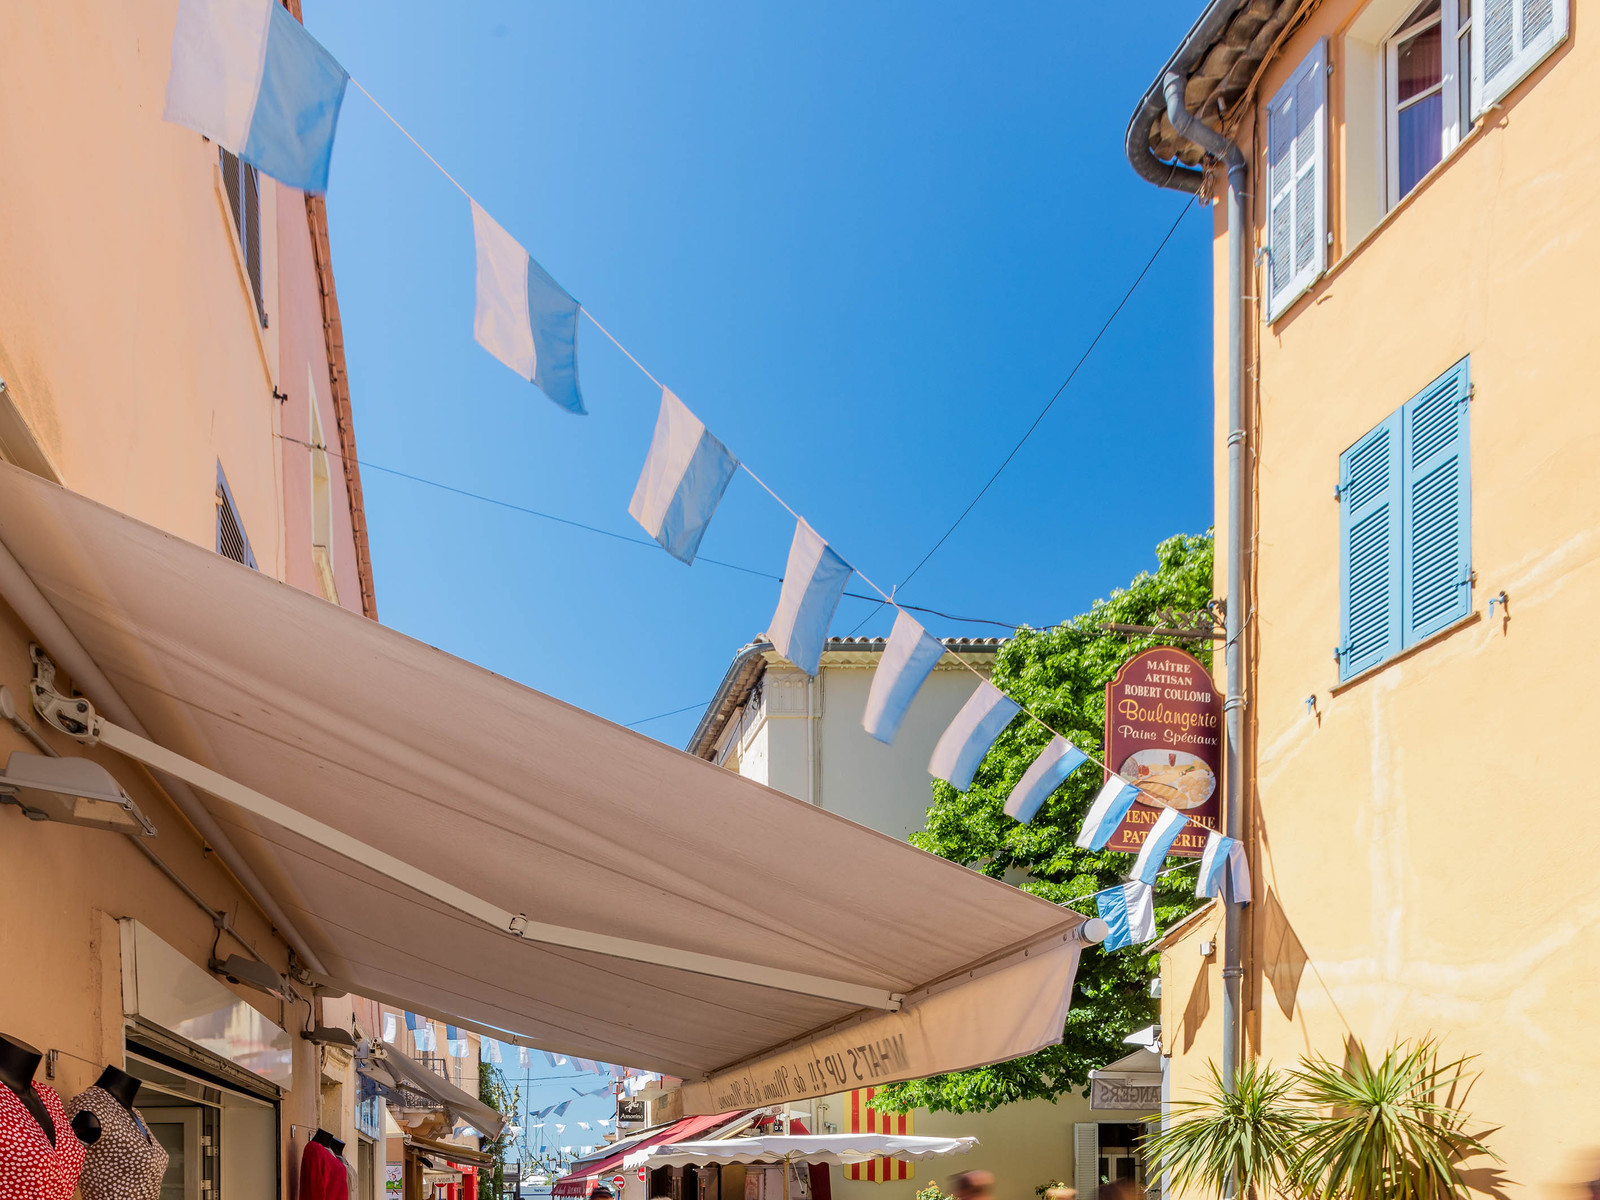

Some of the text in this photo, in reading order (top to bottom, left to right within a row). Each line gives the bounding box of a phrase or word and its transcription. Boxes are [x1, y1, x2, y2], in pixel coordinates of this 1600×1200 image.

[1146, 660, 1191, 674] MAÎTRE
[1144, 673, 1193, 686] ARTISAN
[1124, 684, 1211, 703] ROBERT COULOMB
[1118, 699, 1217, 732] Boulangerie
[1118, 725, 1218, 746] Pains Spéciaux
[1122, 829, 1207, 848] PATERIE
